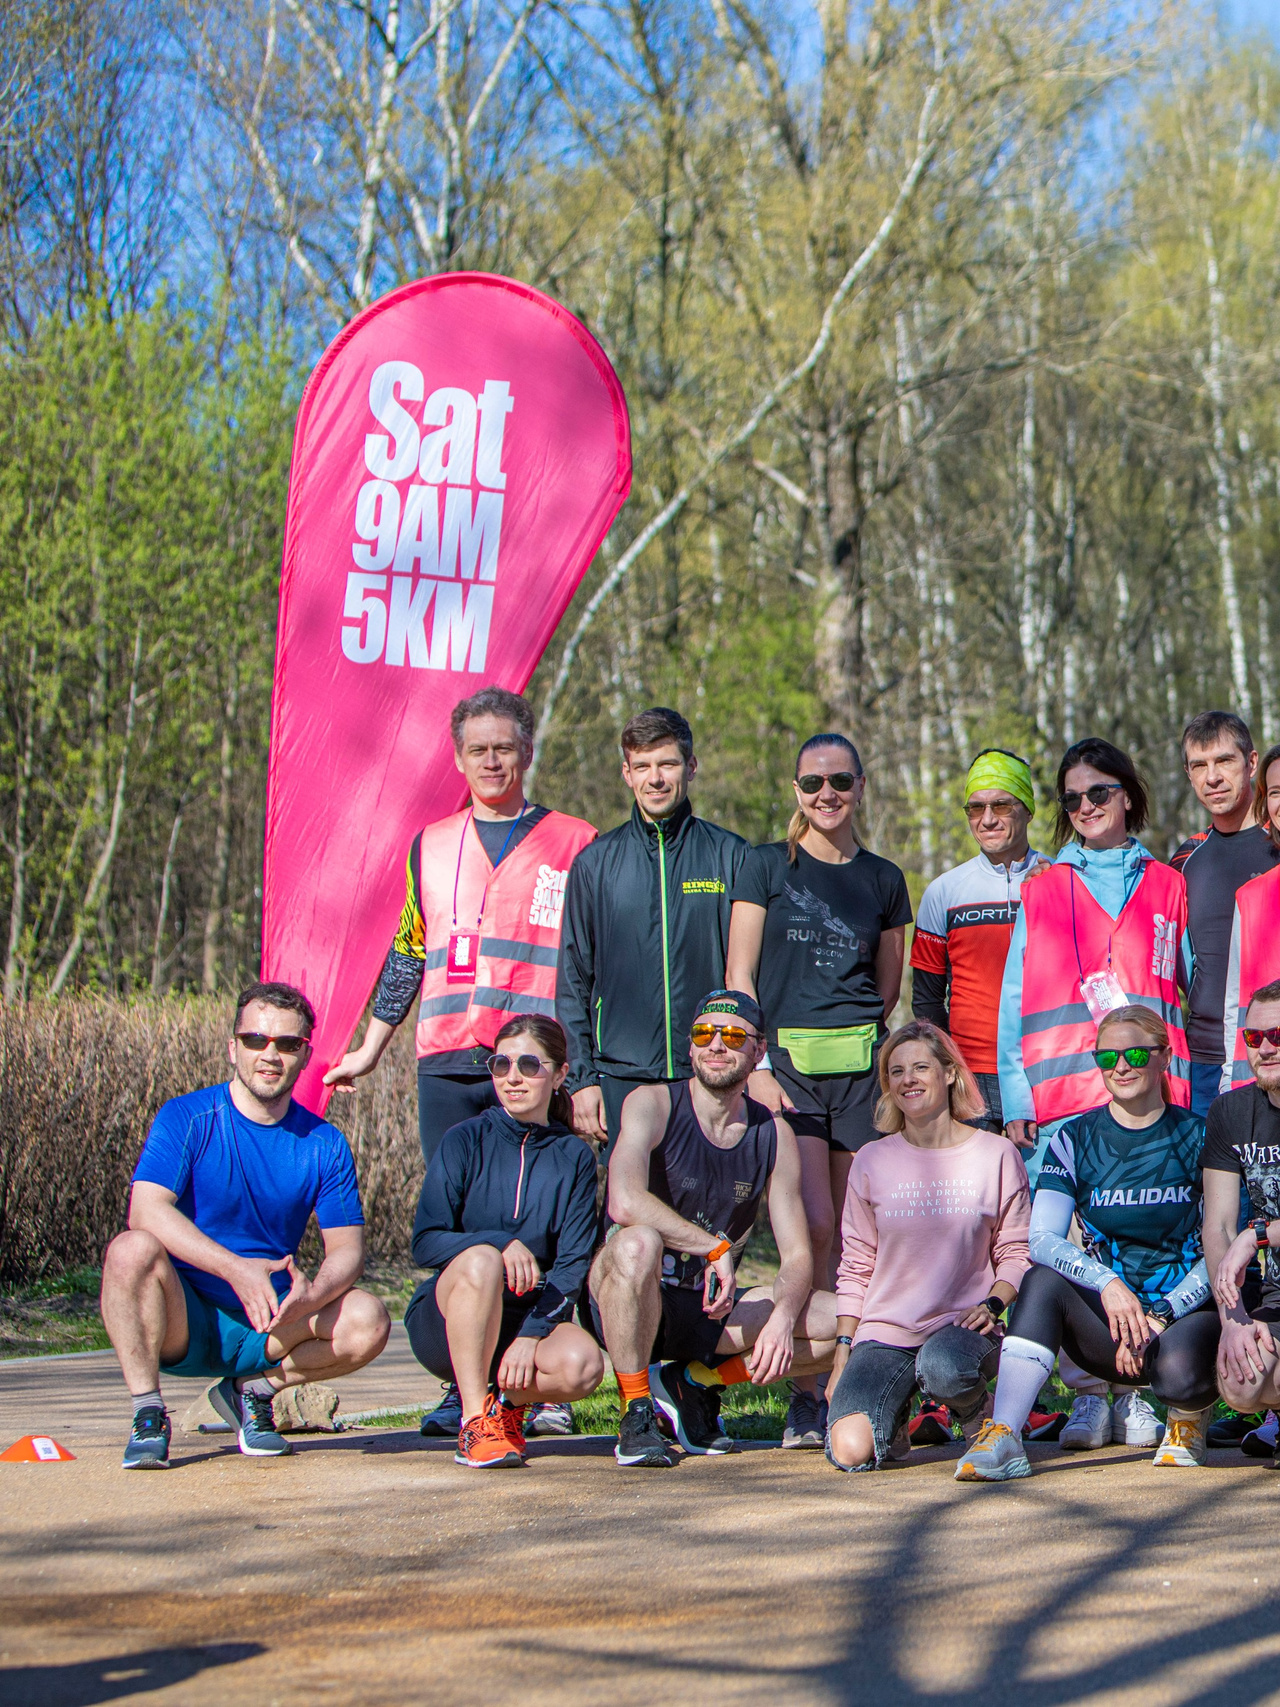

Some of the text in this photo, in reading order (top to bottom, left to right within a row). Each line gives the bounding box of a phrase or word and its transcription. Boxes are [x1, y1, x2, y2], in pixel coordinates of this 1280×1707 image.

[365, 361, 514, 489] Sat
[352, 480, 505, 581] 9AM
[341, 572, 495, 673] 5KM
[532, 887, 565, 911] 9AM
[529, 904, 561, 929] 5KM
[787, 929, 868, 953] RUN CLUB
[810, 947, 844, 958] MOSCOW
[891, 1191, 920, 1199] WITH
[898, 1179, 974, 1190] FALL ASLEEP
[909, 1197, 961, 1207] WAKE UP
[1090, 1185, 1193, 1210] MALIDAK
[884, 1209, 914, 1218] WITH
